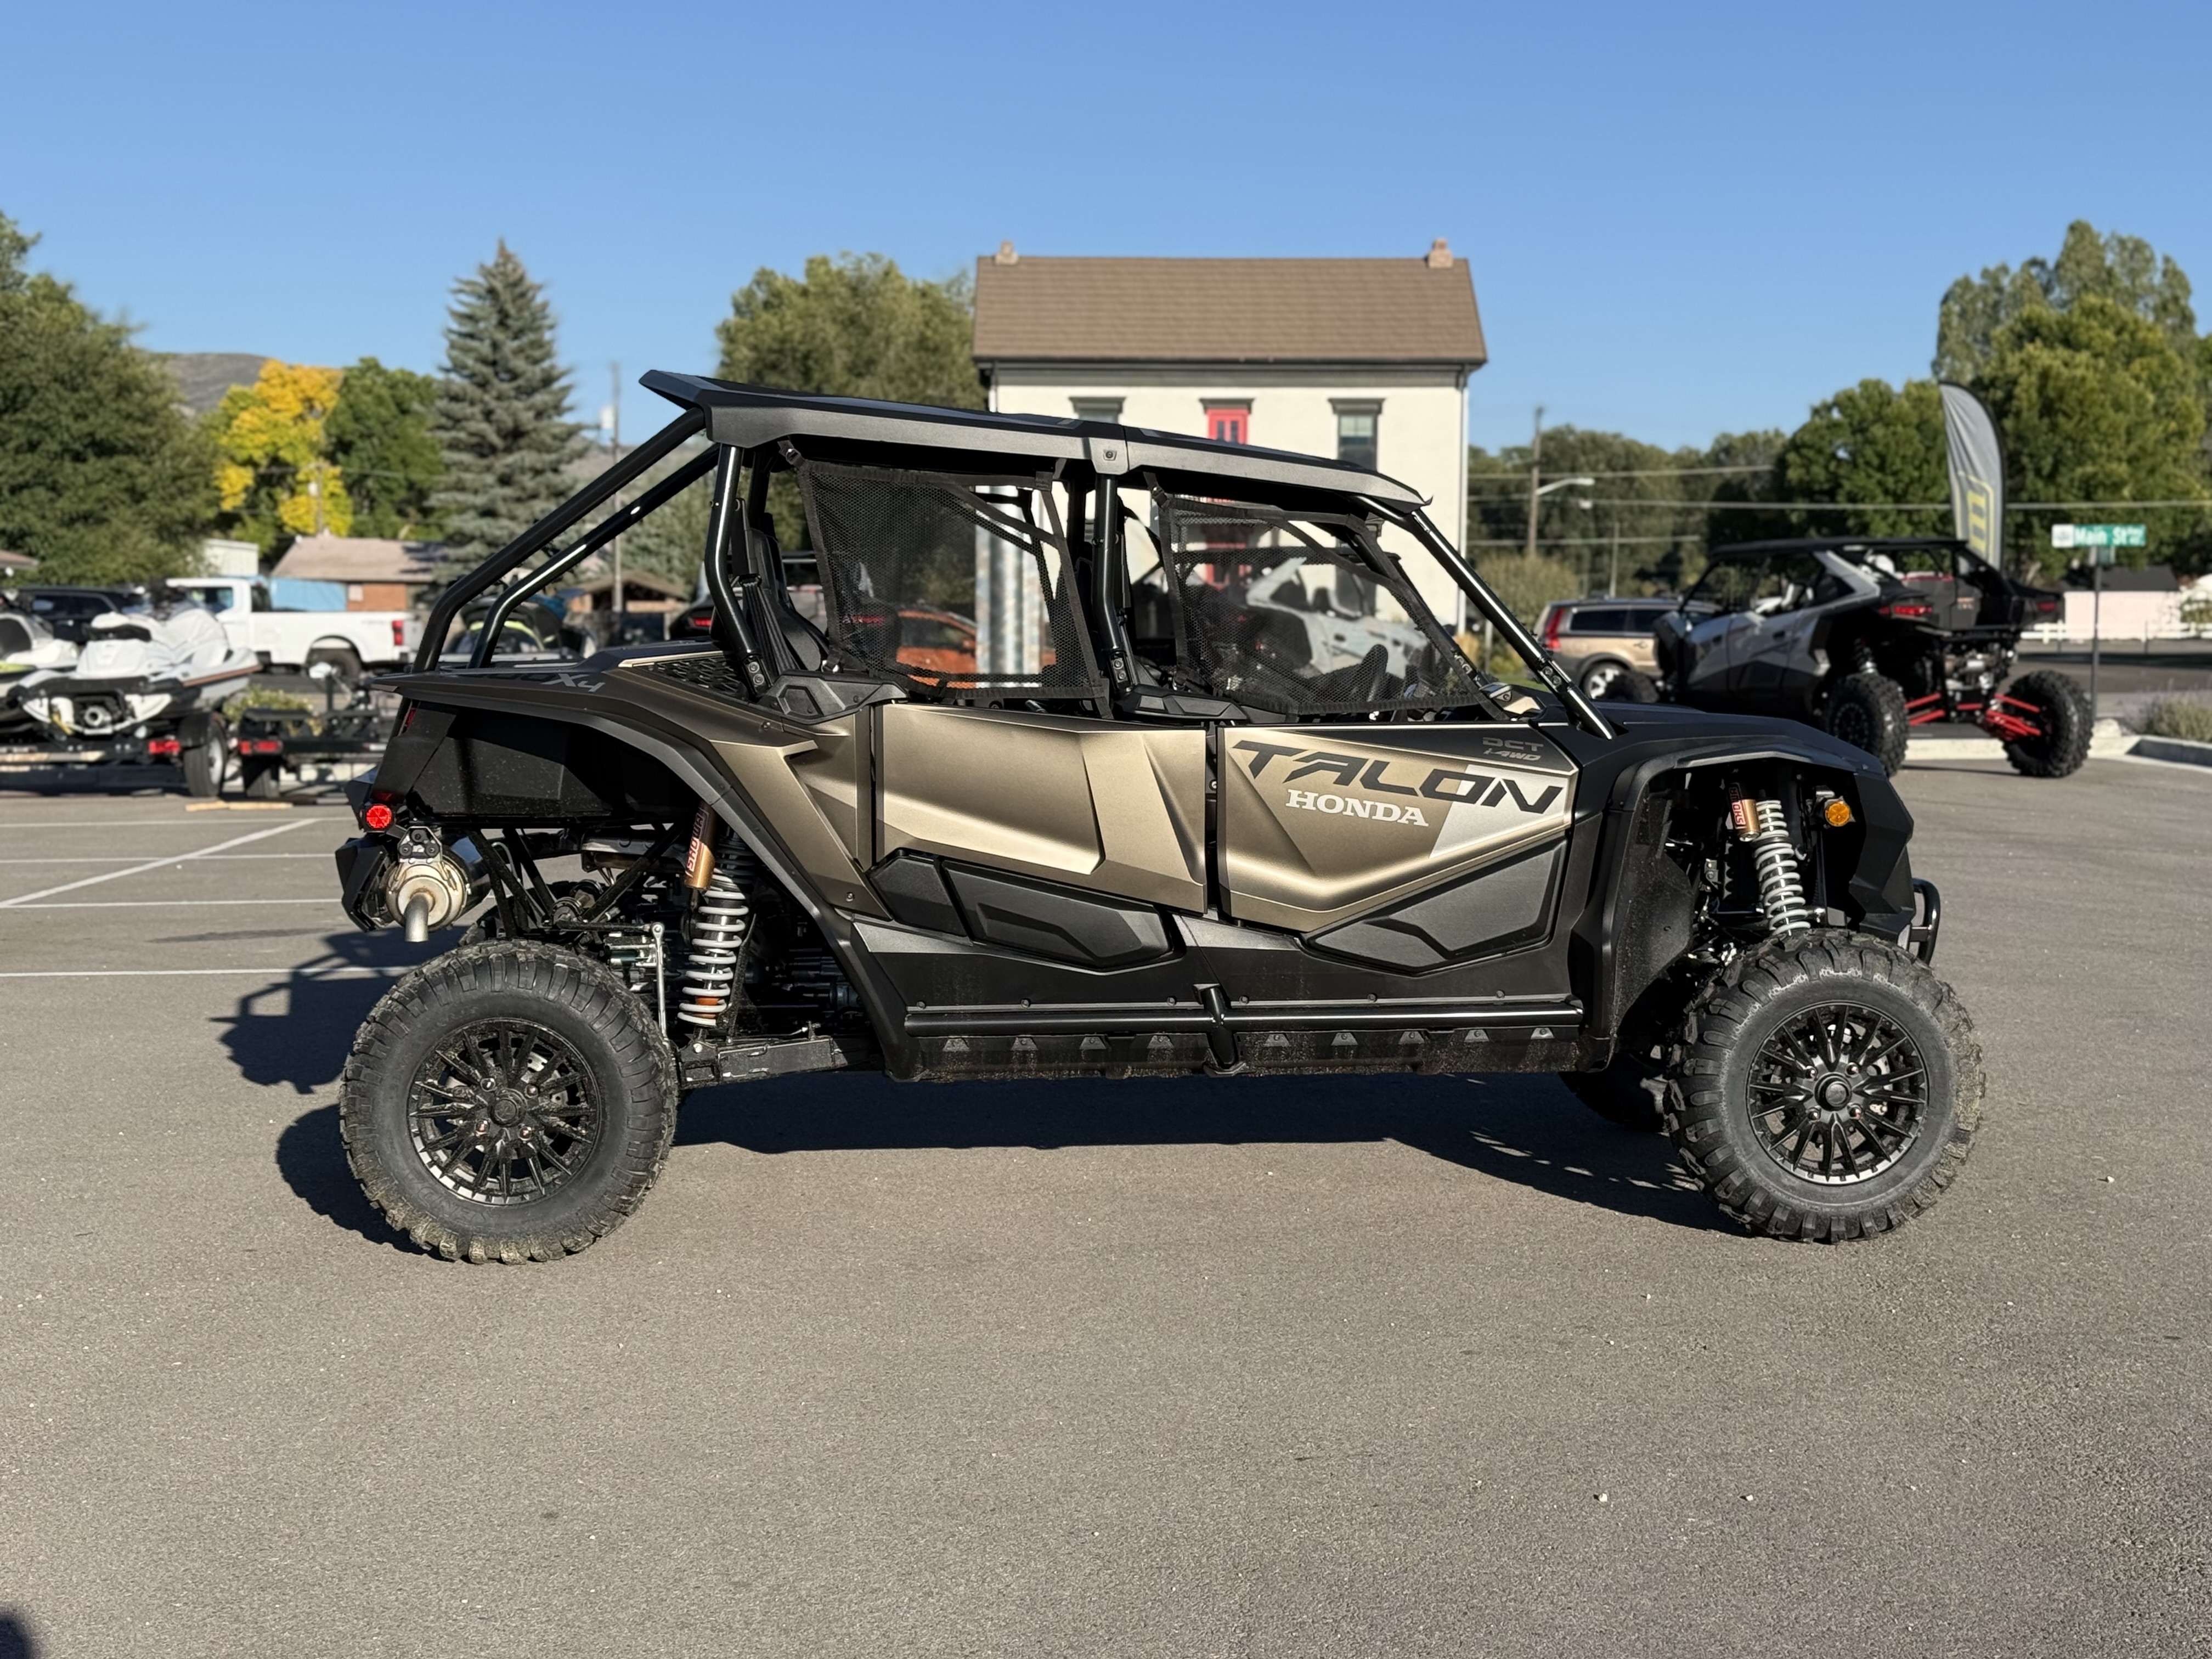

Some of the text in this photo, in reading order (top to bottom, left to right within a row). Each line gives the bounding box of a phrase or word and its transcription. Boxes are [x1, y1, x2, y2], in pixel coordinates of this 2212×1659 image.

[2075, 526, 2107, 545] Main
[2113, 526, 2127, 545] St
[1482, 737, 1544, 752] DCT
[1233, 740, 1564, 814] TALON
[1285, 789, 1429, 826] HONDA
